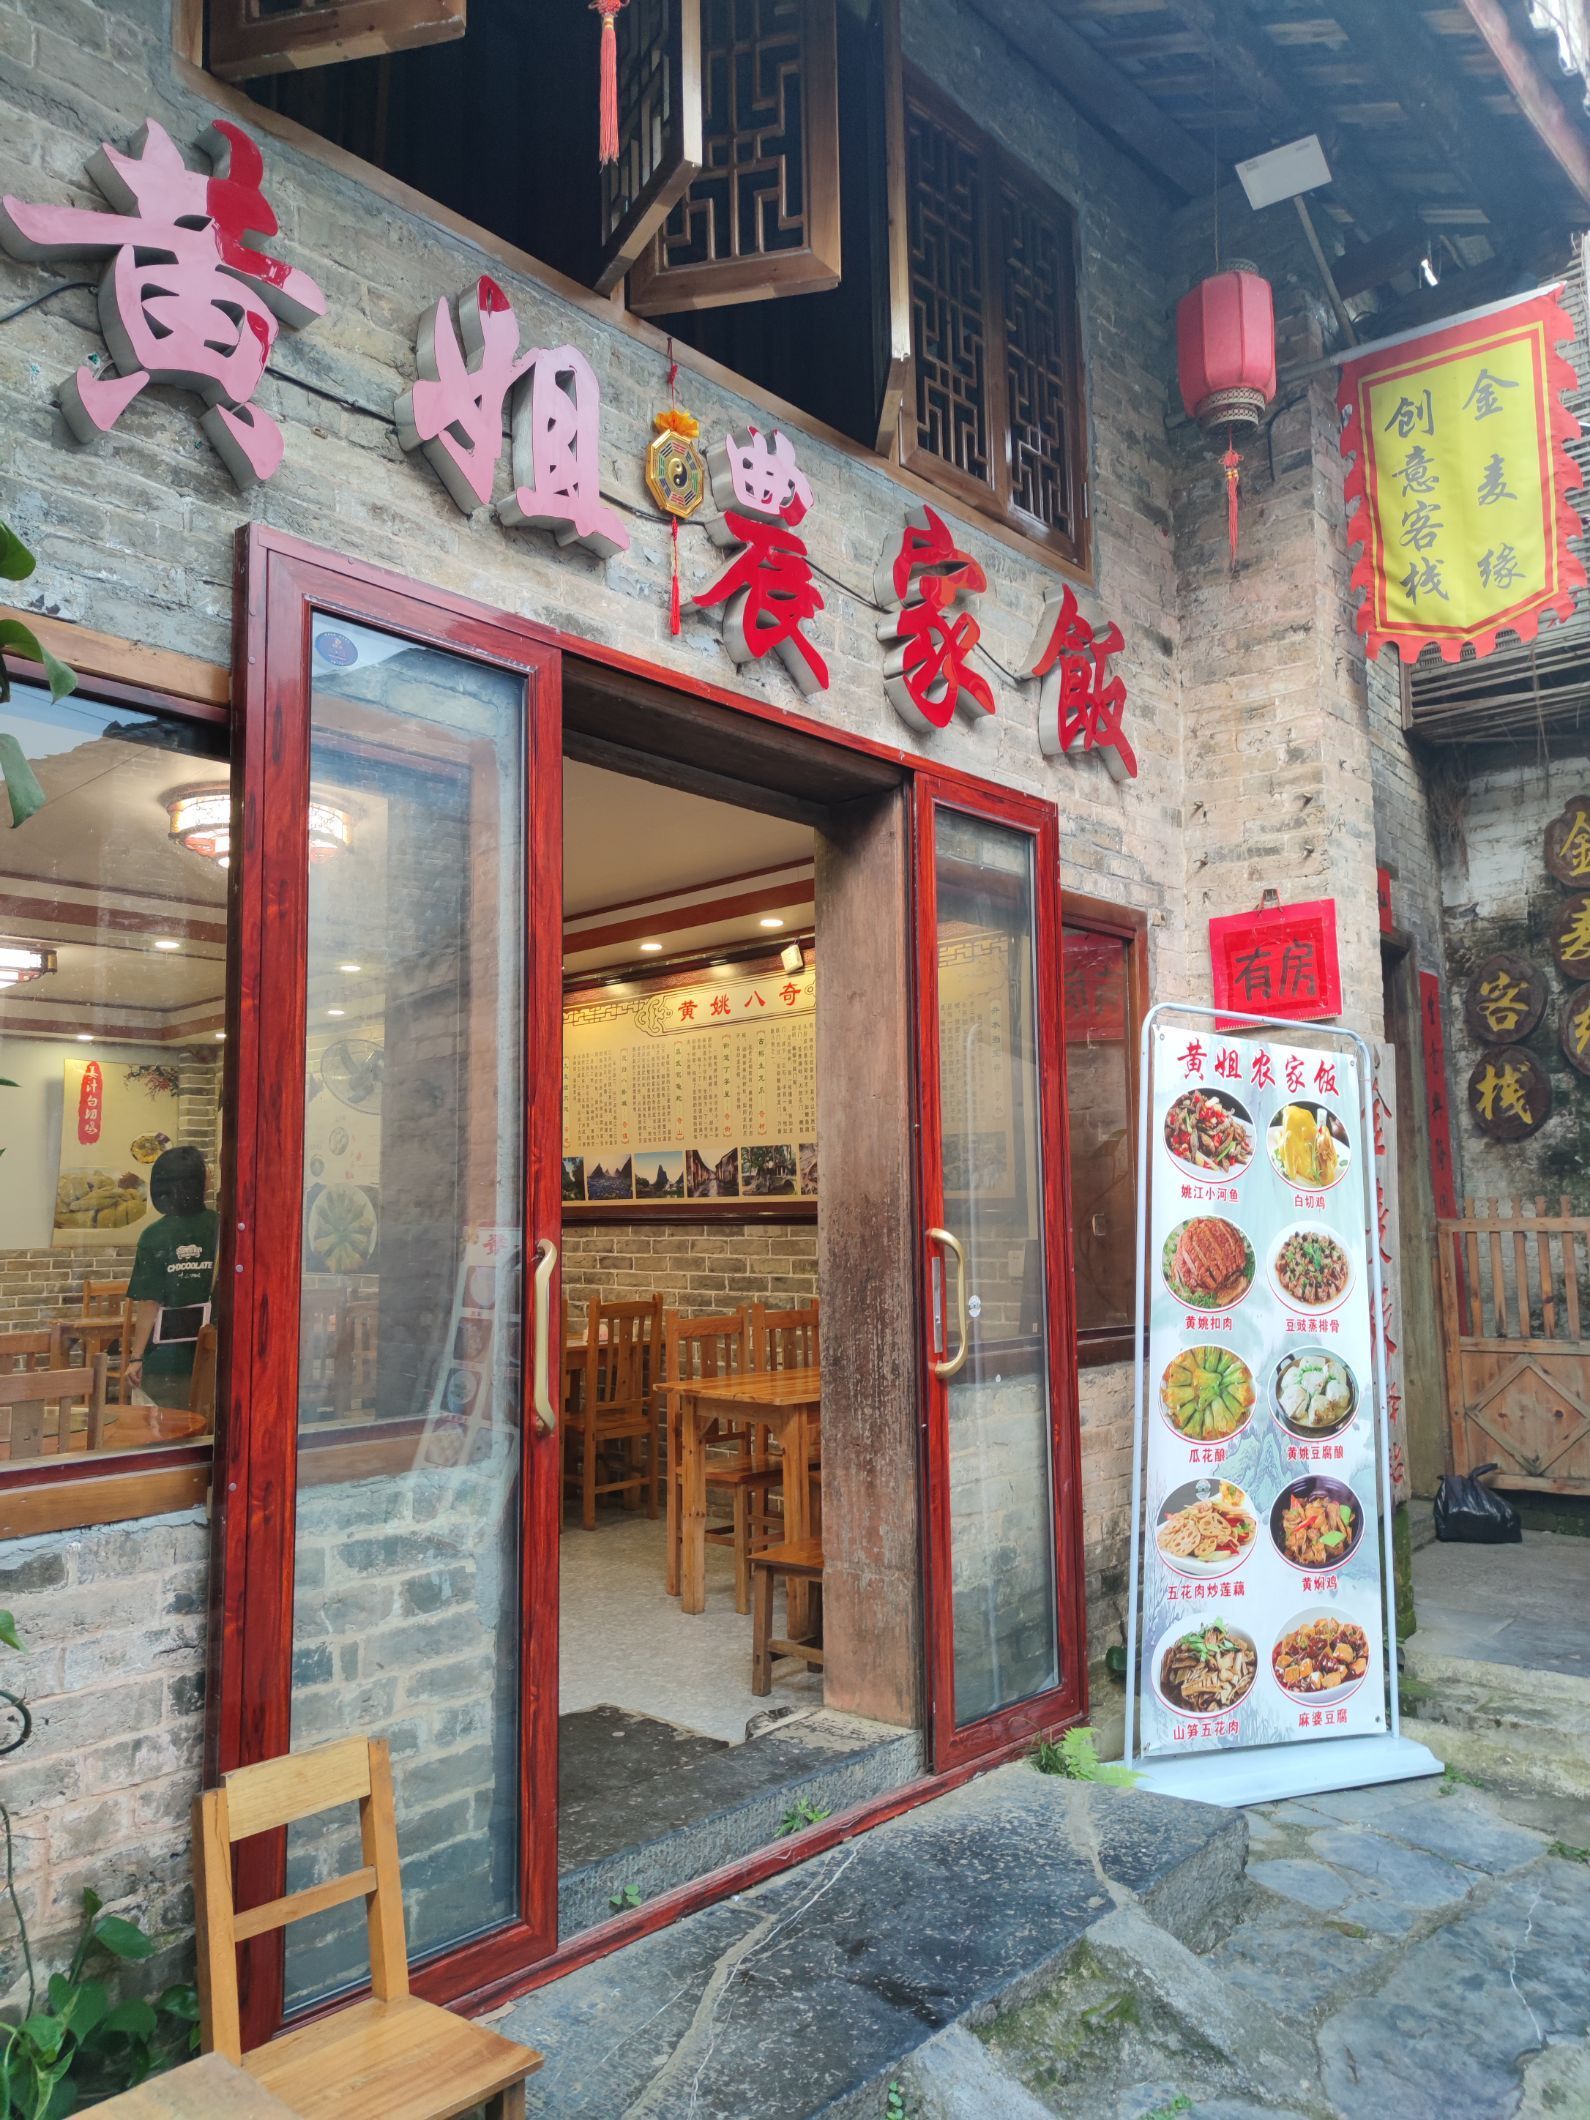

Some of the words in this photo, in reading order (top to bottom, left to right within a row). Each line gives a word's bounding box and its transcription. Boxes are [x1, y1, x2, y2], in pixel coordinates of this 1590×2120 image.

[1462, 368, 1528, 592] 金麦缘
[1384, 388, 1450, 606] 创意客栈
[1234, 939, 1318, 1002] 有房
[677, 981, 802, 1023] 黄姚八奇
[1475, 968, 1534, 1127] 客栈
[1176, 1038, 1341, 1097] 黄姐农家饭
[1181, 1183, 1240, 1203] 姚江小河鱼
[1294, 1194, 1326, 1210] 白切鸡
[1185, 1314, 1233, 1332] 黄姚扣肉
[1285, 1317, 1341, 1334] 豆豉蒸排骨
[1189, 1447, 1226, 1464] 瓜花酿
[1287, 1444, 1344, 1462] 黄姚豆腐酿
[1167, 1580, 1246, 1601] 五花肉炒莲藕
[1301, 1575, 1338, 1593] 黄焖鸡
[1299, 1711, 1348, 1728] 麻婆豆腐
[1173, 1719, 1240, 1741] 山笋五花肉
